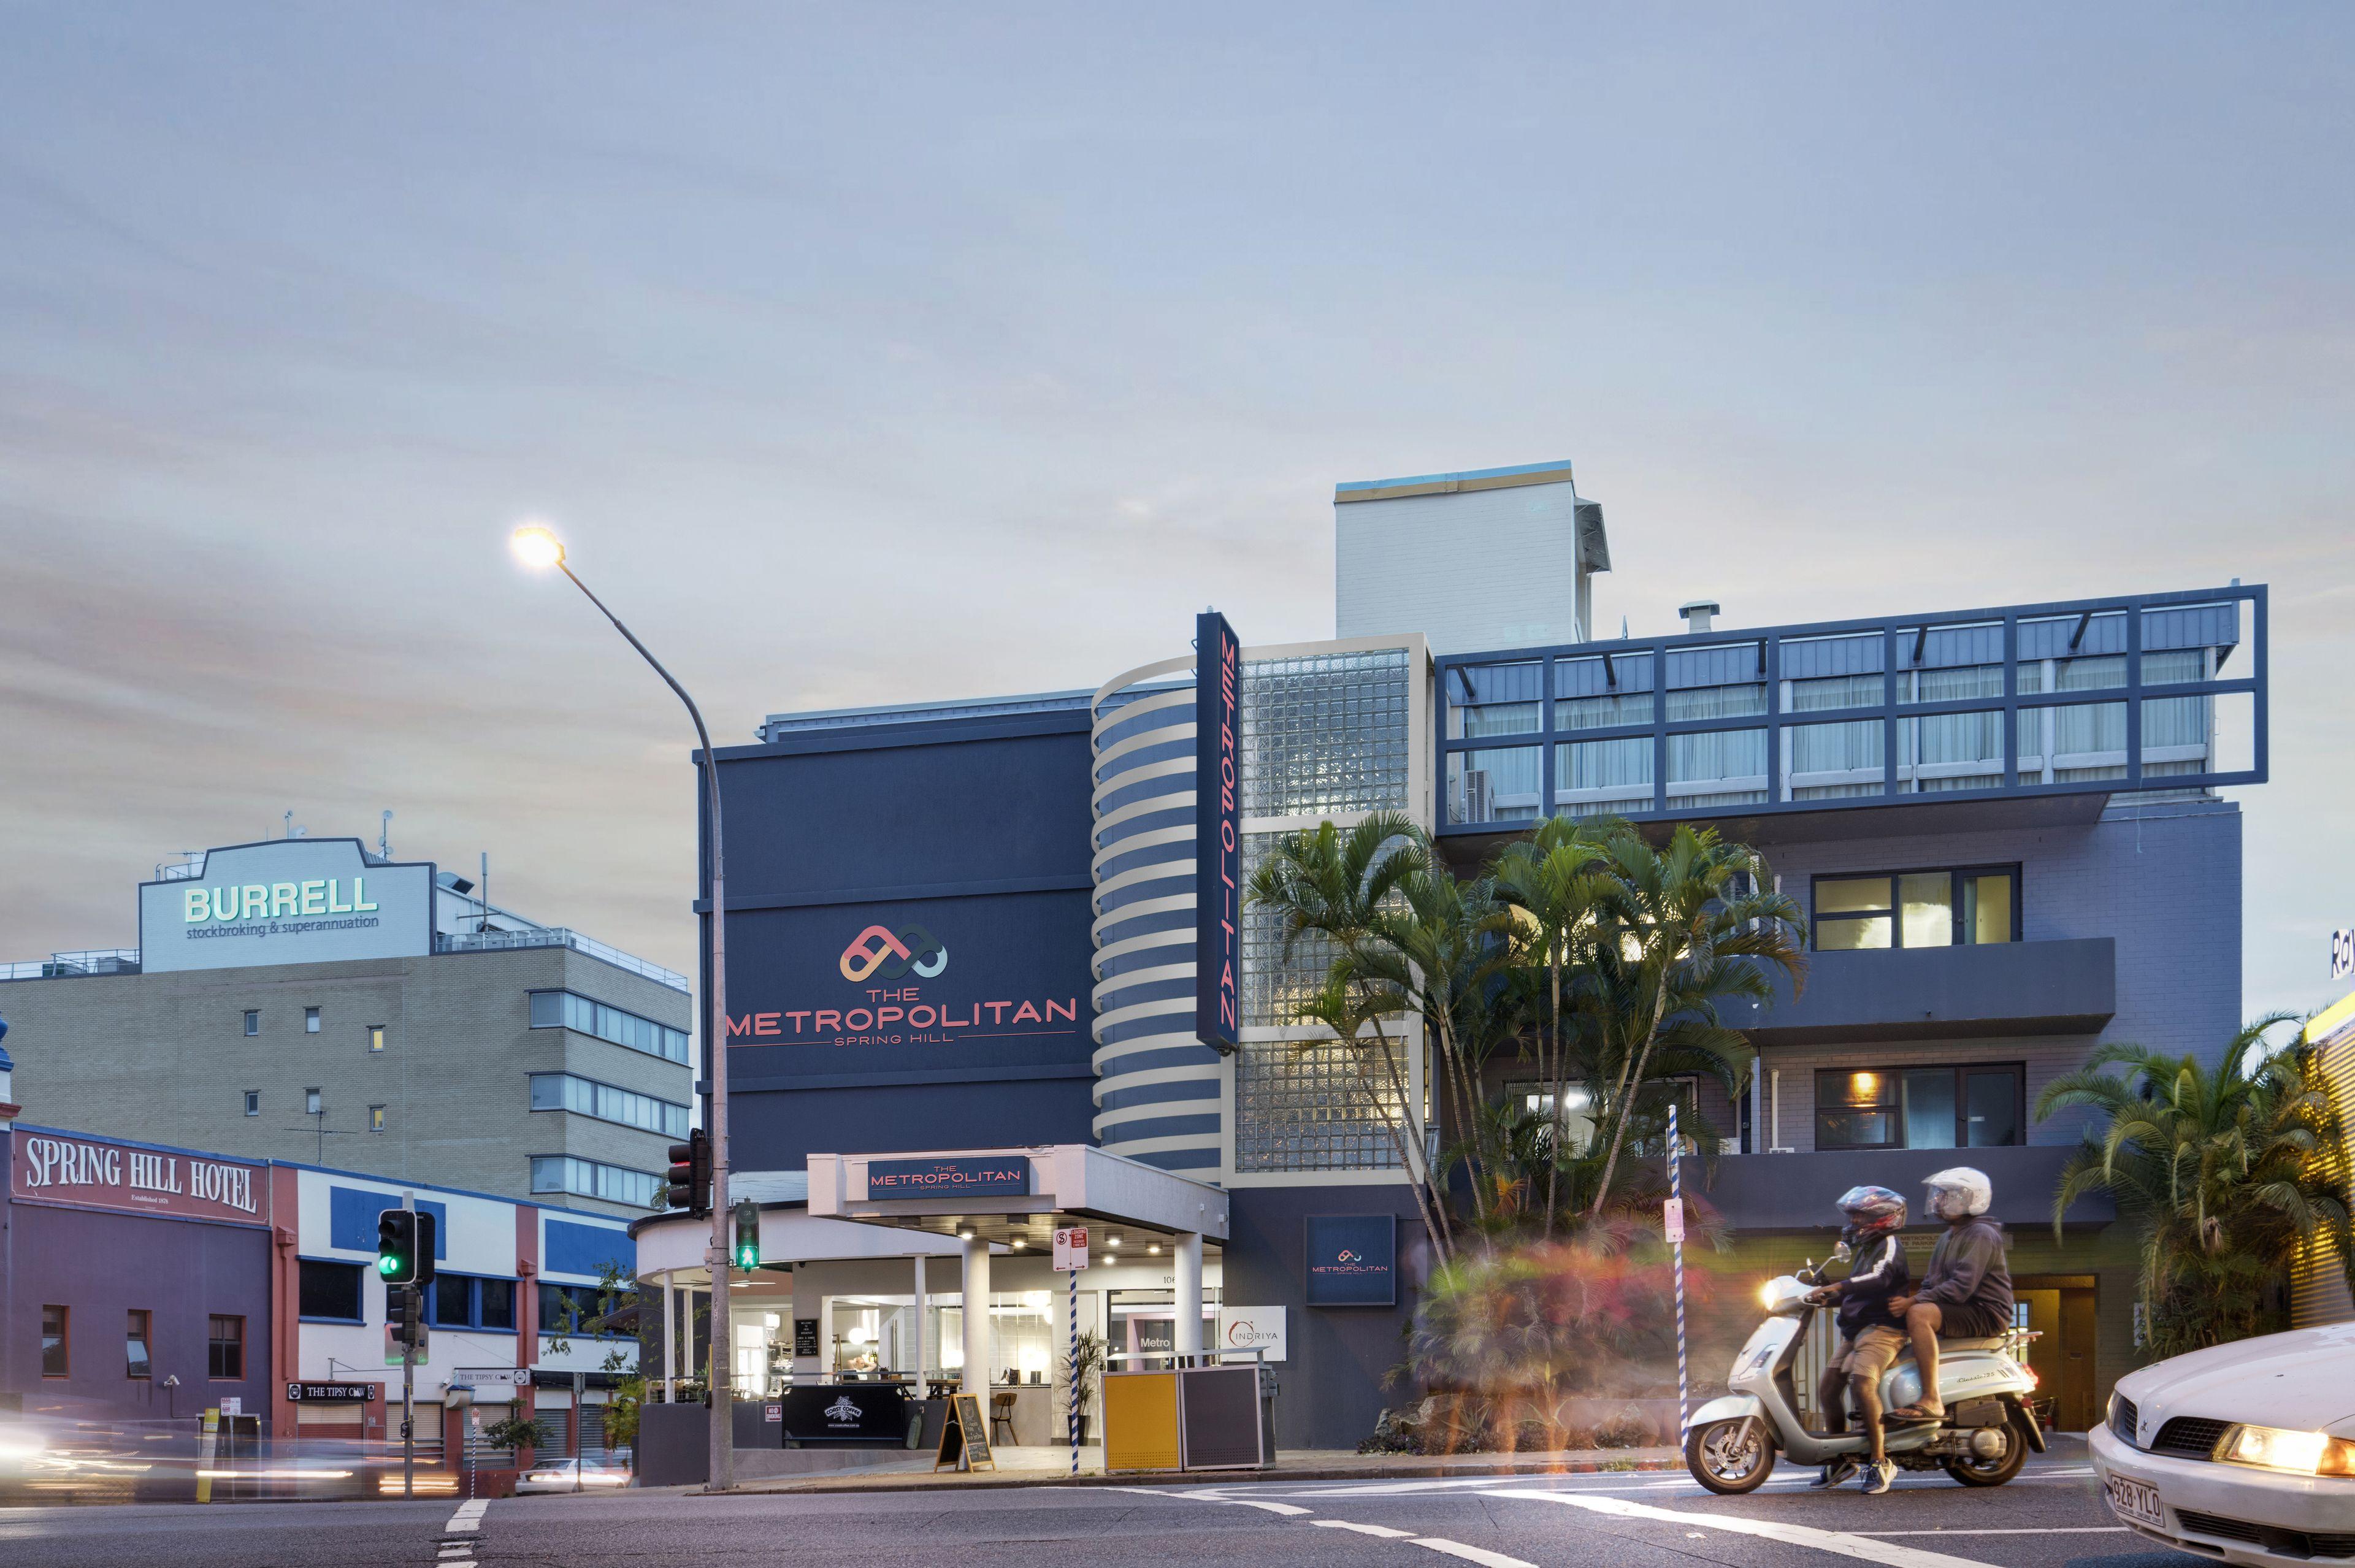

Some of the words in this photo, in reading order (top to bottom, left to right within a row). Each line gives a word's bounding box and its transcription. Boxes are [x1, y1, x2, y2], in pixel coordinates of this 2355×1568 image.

[1220, 630, 1235, 1031] METROPOLITAN
[185, 878, 378, 922] BURRELL
[186, 920, 266, 939] stockbroking
[269, 922, 278, 933] &
[282, 915, 379, 935] superannuation
[866, 987, 920, 1003] THE
[726, 998, 1076, 1037] METROPOLITAN
[835, 1035, 902, 1046] SPRING
[910, 1033, 954, 1043] HILL
[26, 1138, 121, 1187] SPRING
[129, 1152, 182, 1194] HILL
[190, 1161, 257, 1214] HOTEL
[871, 1171, 1020, 1186] METROPOLITAN
[131, 1195, 157, 1203] Established
[1141, 1338, 1170, 1347] Metro
[307, 1387, 325, 1396] THE
[327, 1387, 347, 1396] TIPSY
[843, 1407, 860, 1415] COFFEE
